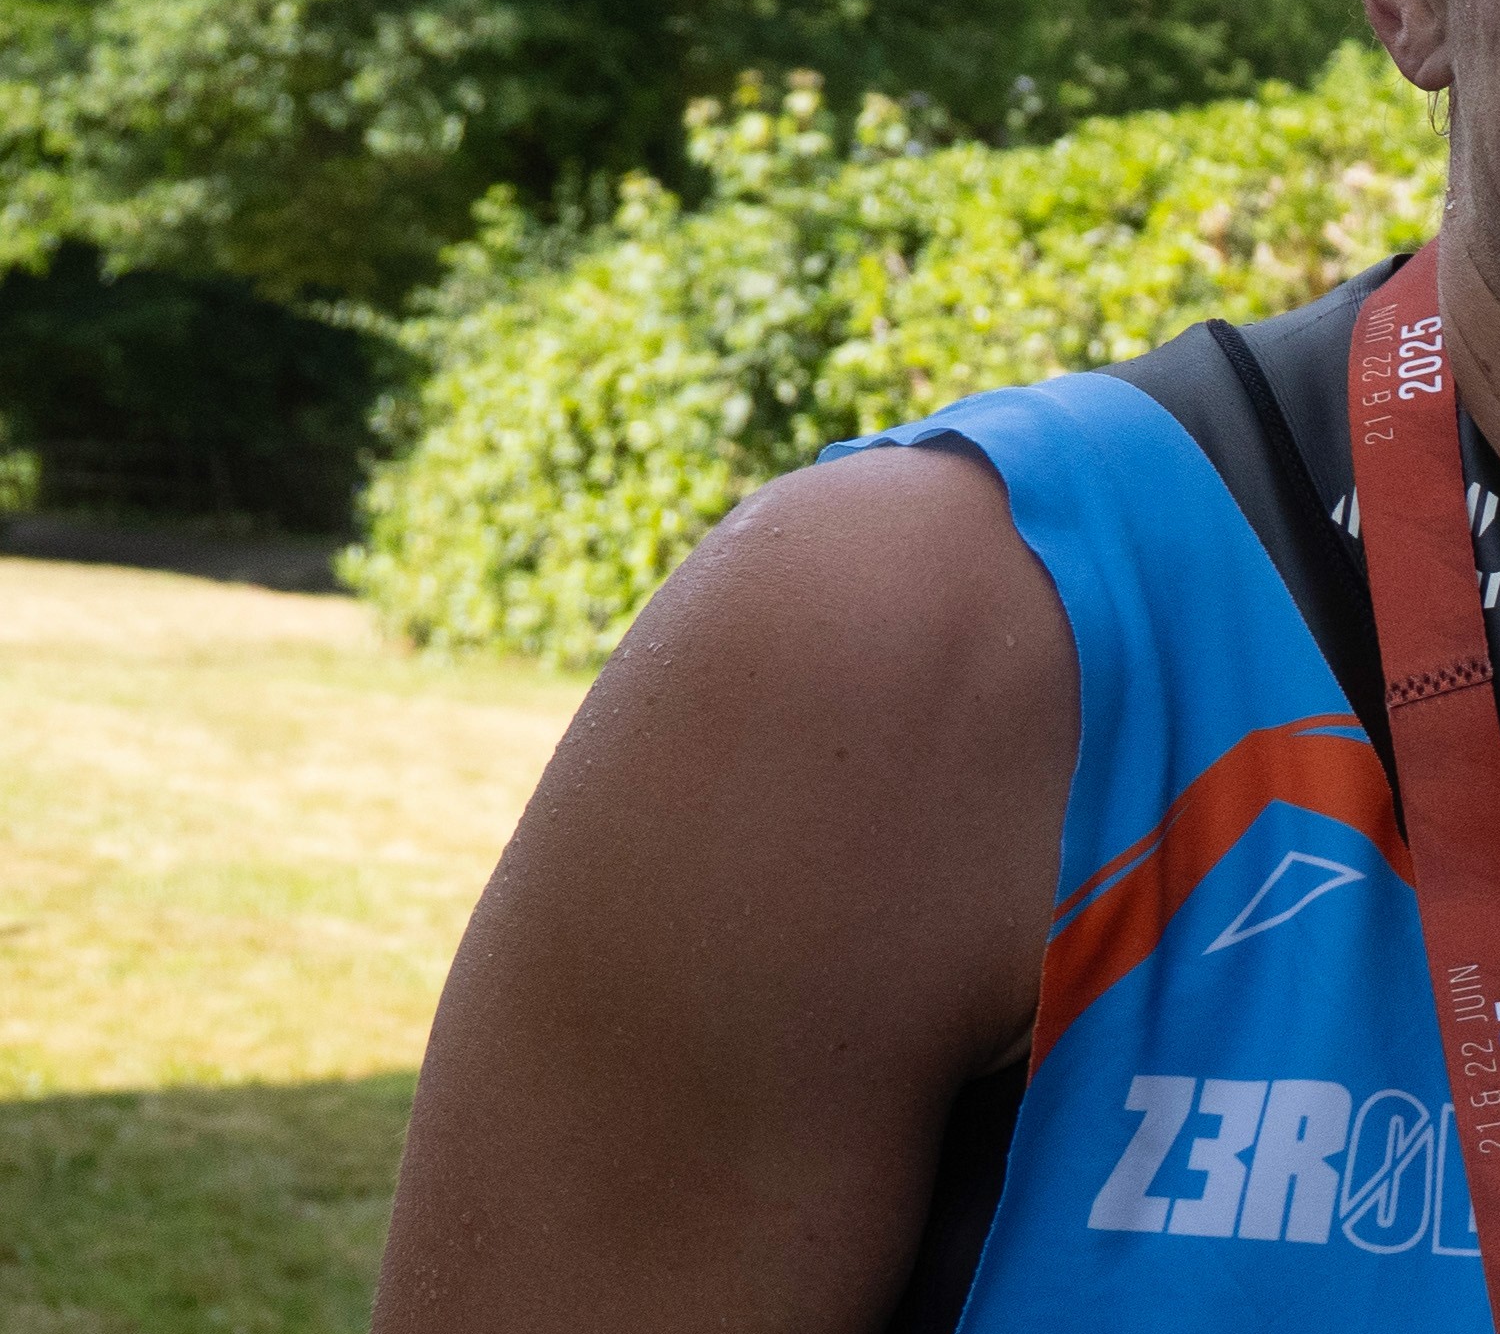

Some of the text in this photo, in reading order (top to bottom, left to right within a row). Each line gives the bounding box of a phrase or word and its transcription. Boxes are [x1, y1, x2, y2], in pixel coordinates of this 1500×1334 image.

[1364, 303, 1399, 344] JUIN
[1362, 352, 1392, 382] 22
[1397, 316, 1443, 401] 2025
[1364, 414, 1394, 445] 21
[1448, 964, 1490, 1023] JUIN
[1461, 1039, 1498, 1077] 22
